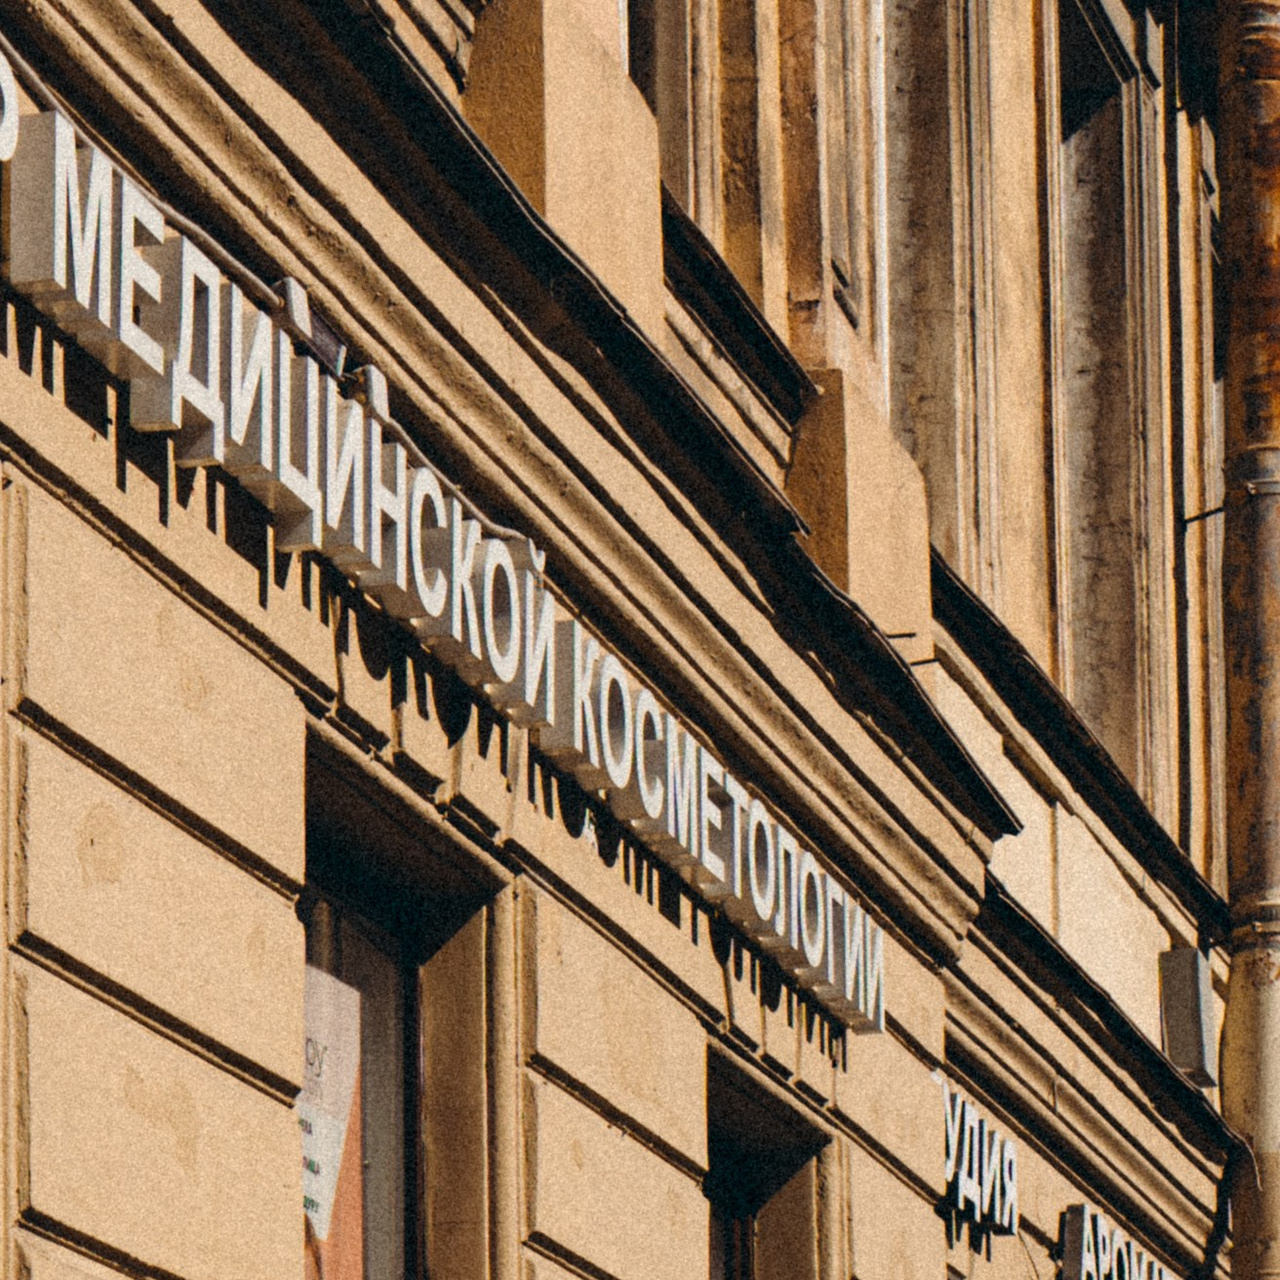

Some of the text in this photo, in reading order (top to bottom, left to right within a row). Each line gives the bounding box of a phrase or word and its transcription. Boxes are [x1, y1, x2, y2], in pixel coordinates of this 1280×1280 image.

[53, 110, 556, 727] МЕДИЦИНСКОЙ
[573, 620, 886, 1034] КОСМЕТОЛОГИИ
[932, 1071, 1018, 1235] УДИЯ
